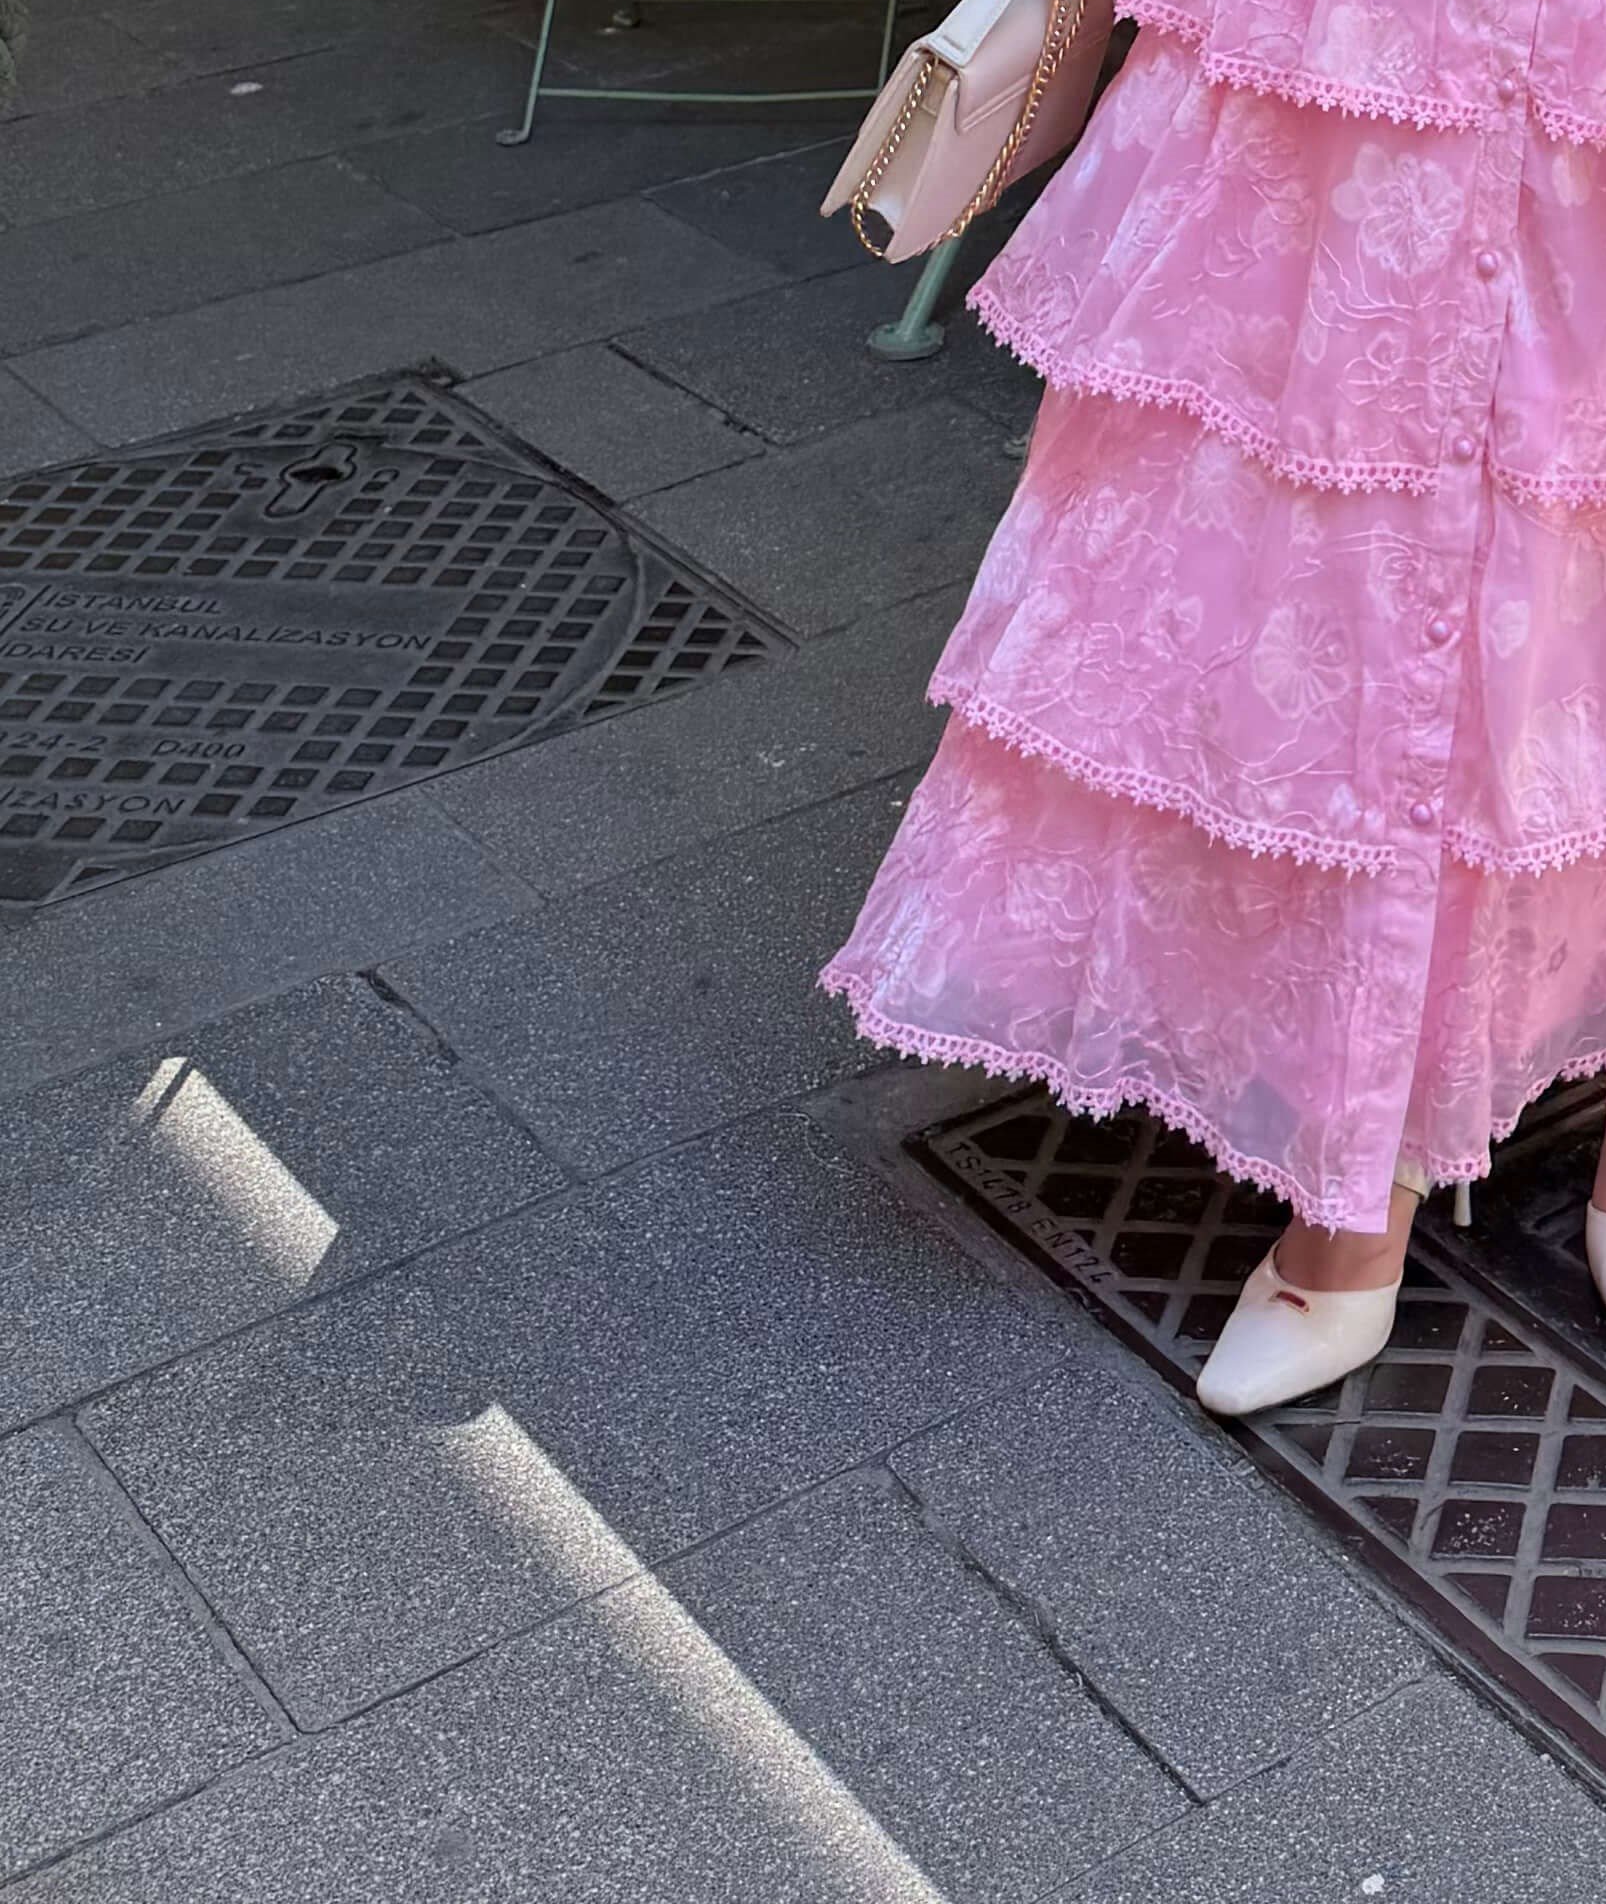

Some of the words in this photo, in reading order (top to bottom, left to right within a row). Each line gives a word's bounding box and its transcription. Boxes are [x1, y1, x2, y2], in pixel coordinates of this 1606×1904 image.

[20, 616, 74, 634] SU
[86, 618, 132, 636] VE
[152, 739, 247, 759] D400
